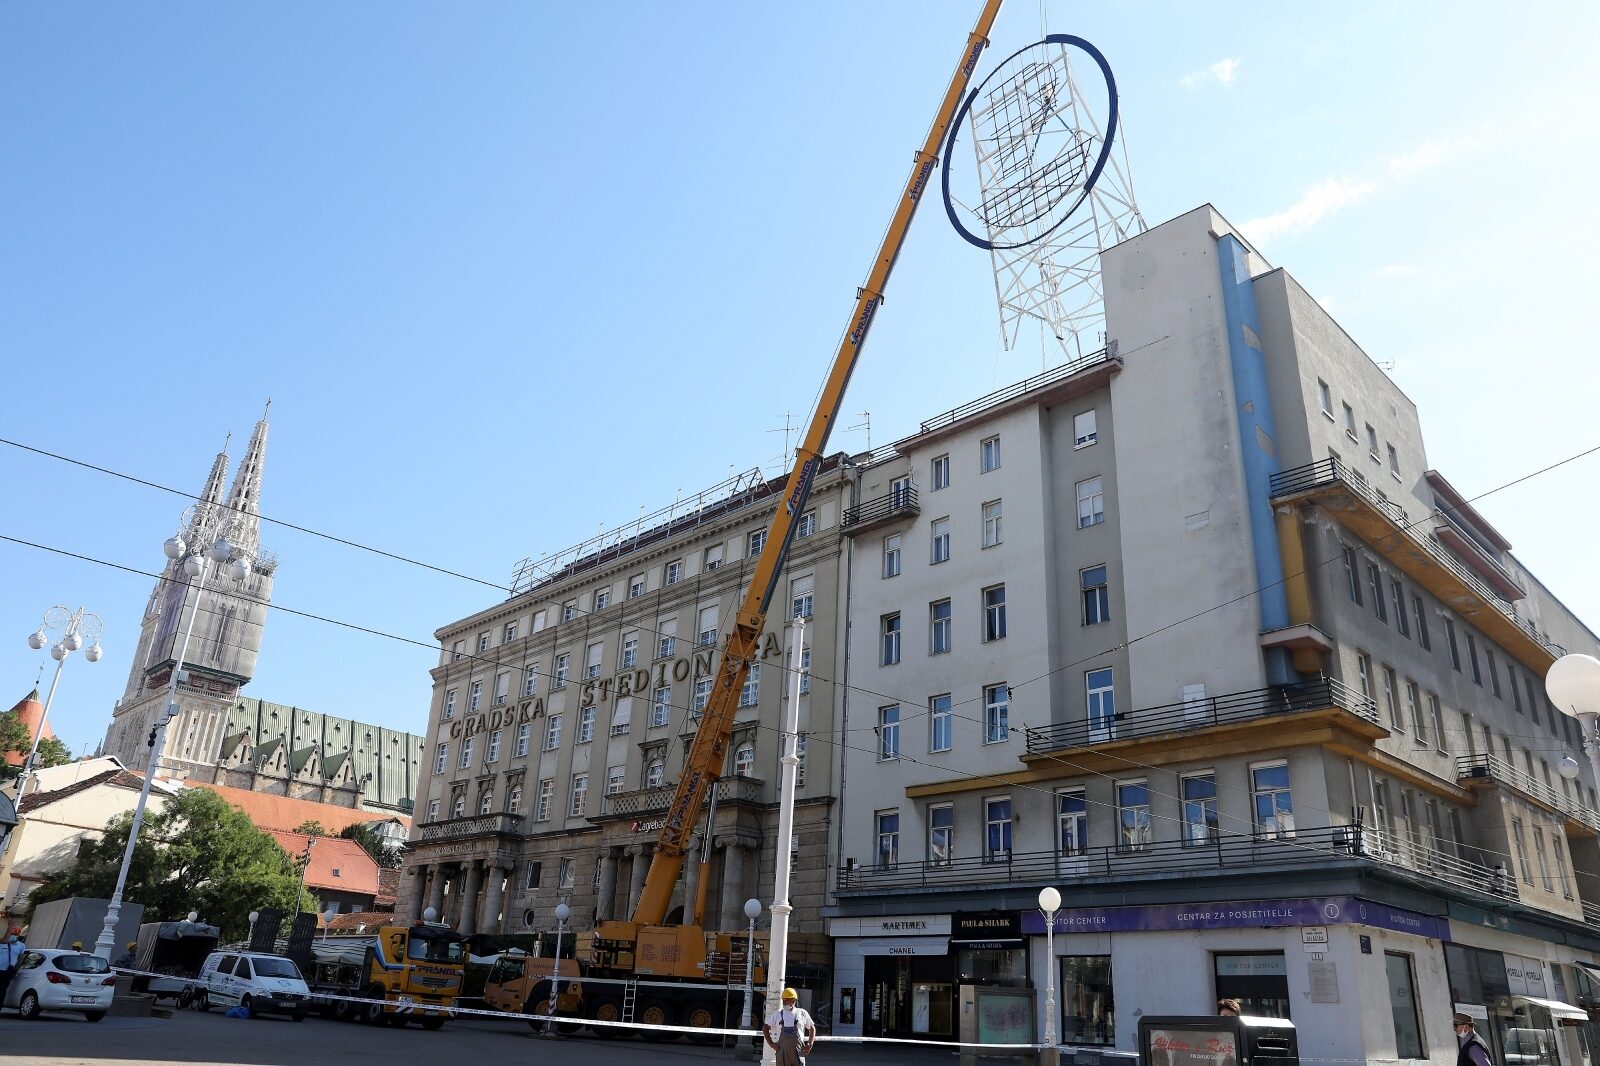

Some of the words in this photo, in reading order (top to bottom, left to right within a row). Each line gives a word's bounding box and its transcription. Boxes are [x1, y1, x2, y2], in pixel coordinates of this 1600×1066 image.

[913, 160, 932, 194] PRANGL
[855, 298, 876, 337] PRANGL
[791, 459, 813, 504] PRANGL
[450, 698, 546, 740] GRADSKA
[582, 632, 781, 707] ŠTEDIONA
[881, 921, 927, 930] MARTIMEX
[1076, 916, 1106, 925] CENTER
[1177, 913, 1211, 921] CENTAR
[1214, 912, 1226, 920] ZA
[1229, 909, 1293, 919] POSJETITELJE
[417, 966, 460, 977] PRANGL
